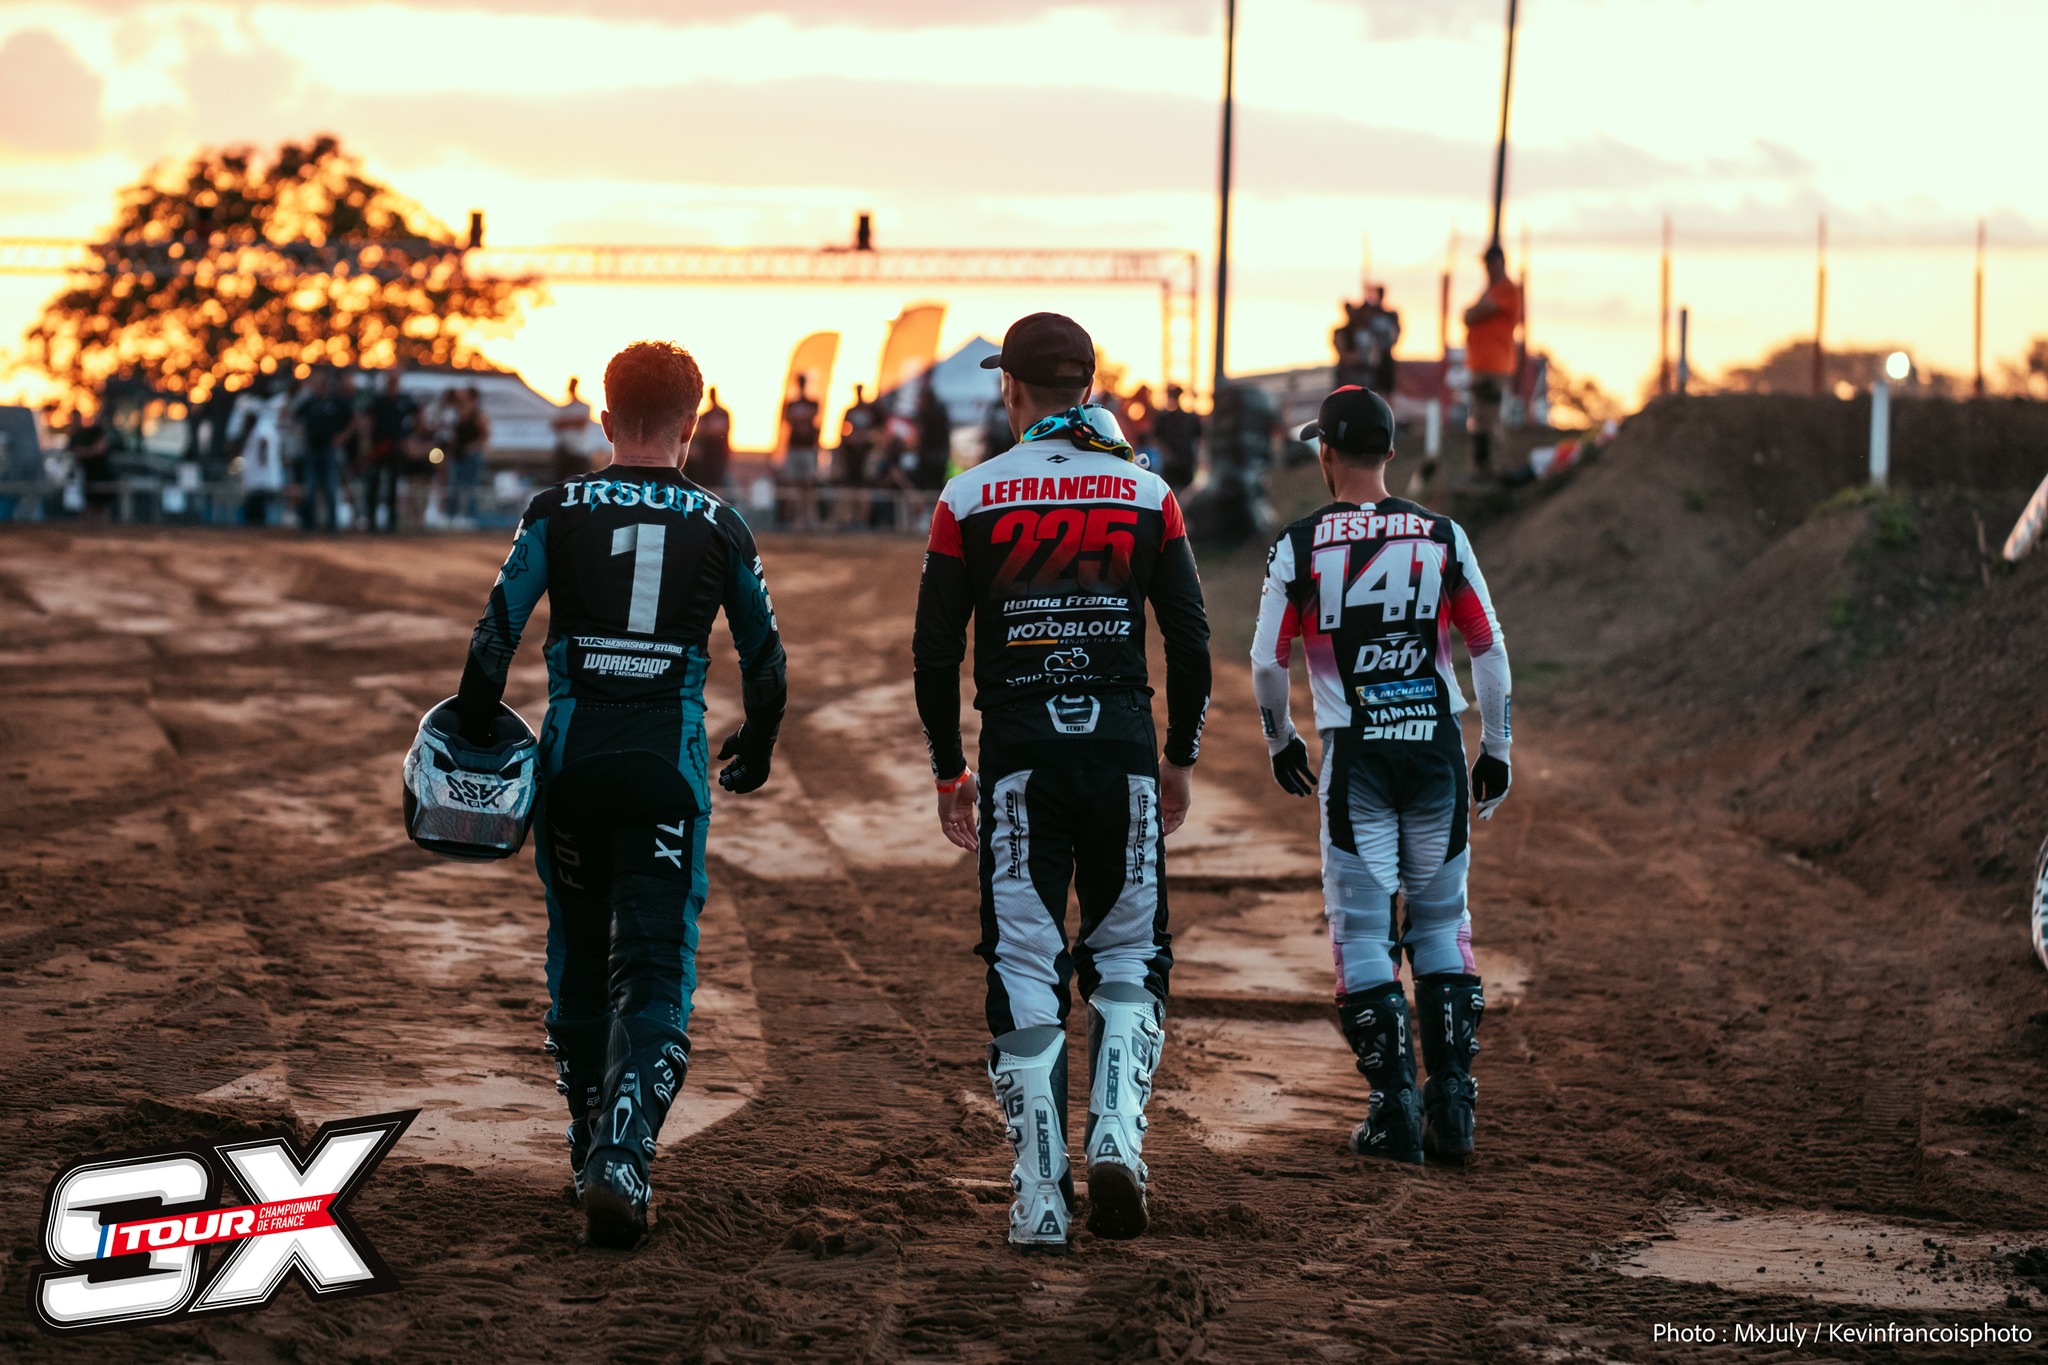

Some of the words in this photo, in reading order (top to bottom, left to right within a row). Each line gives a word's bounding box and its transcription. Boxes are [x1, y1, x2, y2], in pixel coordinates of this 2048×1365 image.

[982, 475, 1137, 507] LEFRANCOIS
[1322, 510, 1375, 522] Maxime
[1312, 513, 1435, 547] DESPREY
[990, 508, 1139, 595] 225
[611, 523, 666, 635] 1
[1311, 539, 1448, 630] 141
[1003, 597, 1062, 612] Honda
[1066, 595, 1128, 607] France
[1007, 620, 1131, 641] MOTOBLOUZ
[604, 639, 653, 651] WORKSHOP
[654, 643, 683, 654] STUDIO
[1353, 640, 1427, 676] Dafy
[583, 653, 671, 675] WORKSHOP
[1380, 685, 1433, 698] MICHELIN
[1367, 704, 1437, 725] YAMAHA
[655, 820, 685, 869] XL
